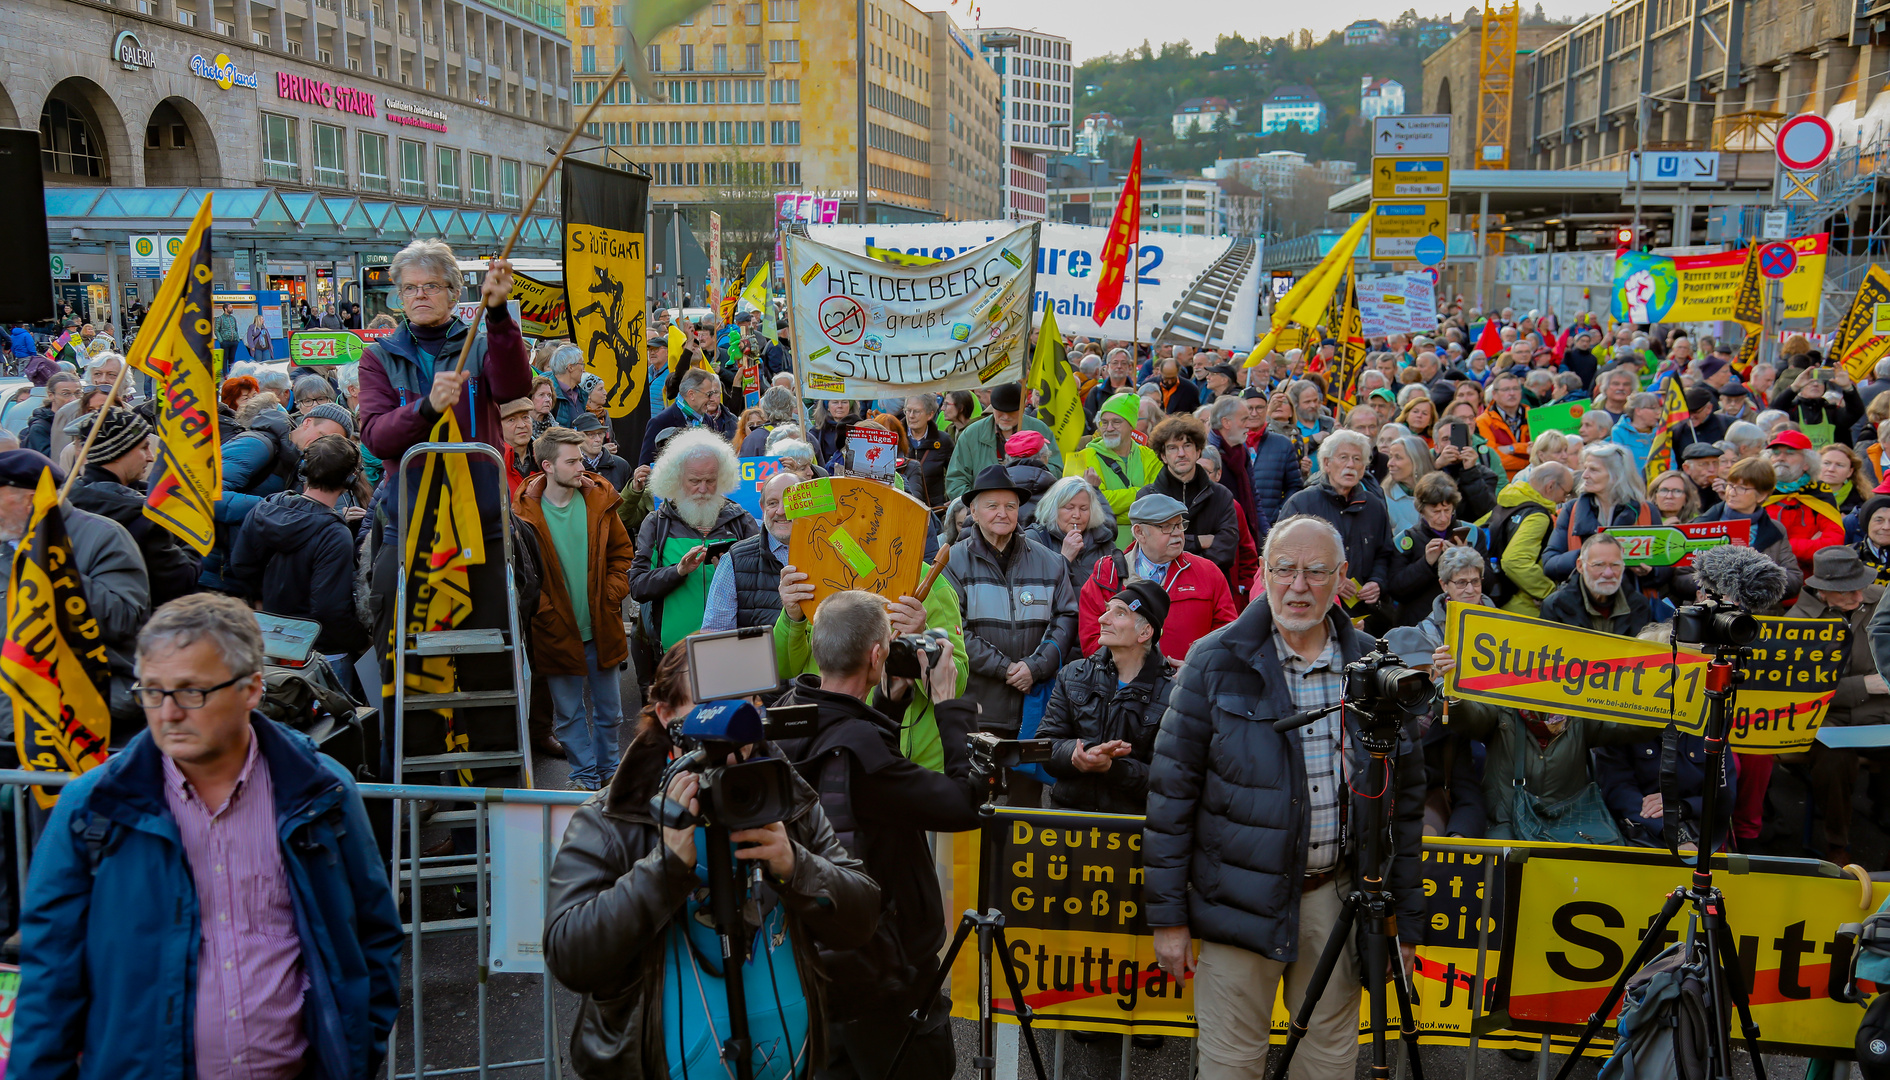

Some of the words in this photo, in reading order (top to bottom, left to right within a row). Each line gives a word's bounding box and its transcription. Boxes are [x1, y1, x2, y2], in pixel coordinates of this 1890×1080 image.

[121, 45, 157, 69] GALERIA
[190, 54, 225, 81] Photo
[276, 71, 334, 108] BRUNO
[335, 85, 378, 118] STÄRK
[1407, 121, 1449, 129] Liederhalle
[1395, 132, 1433, 141] Hegelplatz
[1379, 218, 1426, 227] Ludwigsburg
[1375, 247, 1416, 257] Europaviert
[368, 271, 380, 281] 47
[512, 275, 546, 296] aildorf
[825, 257, 1002, 302] HEIDELBERG
[1714, 271, 1728, 281] DIE
[513, 291, 568, 331] tuttga
[824, 305, 861, 338] S21
[832, 341, 998, 383] STUTTGART
[868, 434, 892, 444] lügen
[786, 480, 819, 494] RACKETE
[787, 491, 812, 503] RESCH
[789, 499, 814, 511] LÖSCH
[1689, 526, 1708, 536] weg
[1759, 622, 1846, 642] hlands
[1751, 647, 1842, 663] mstes
[1470, 631, 1648, 697] Stuttgart
[1652, 661, 1702, 704] 21
[1739, 664, 1838, 687] projek
[1012, 820, 1142, 852] Deutsc
[1011, 886, 1139, 925] Großp
